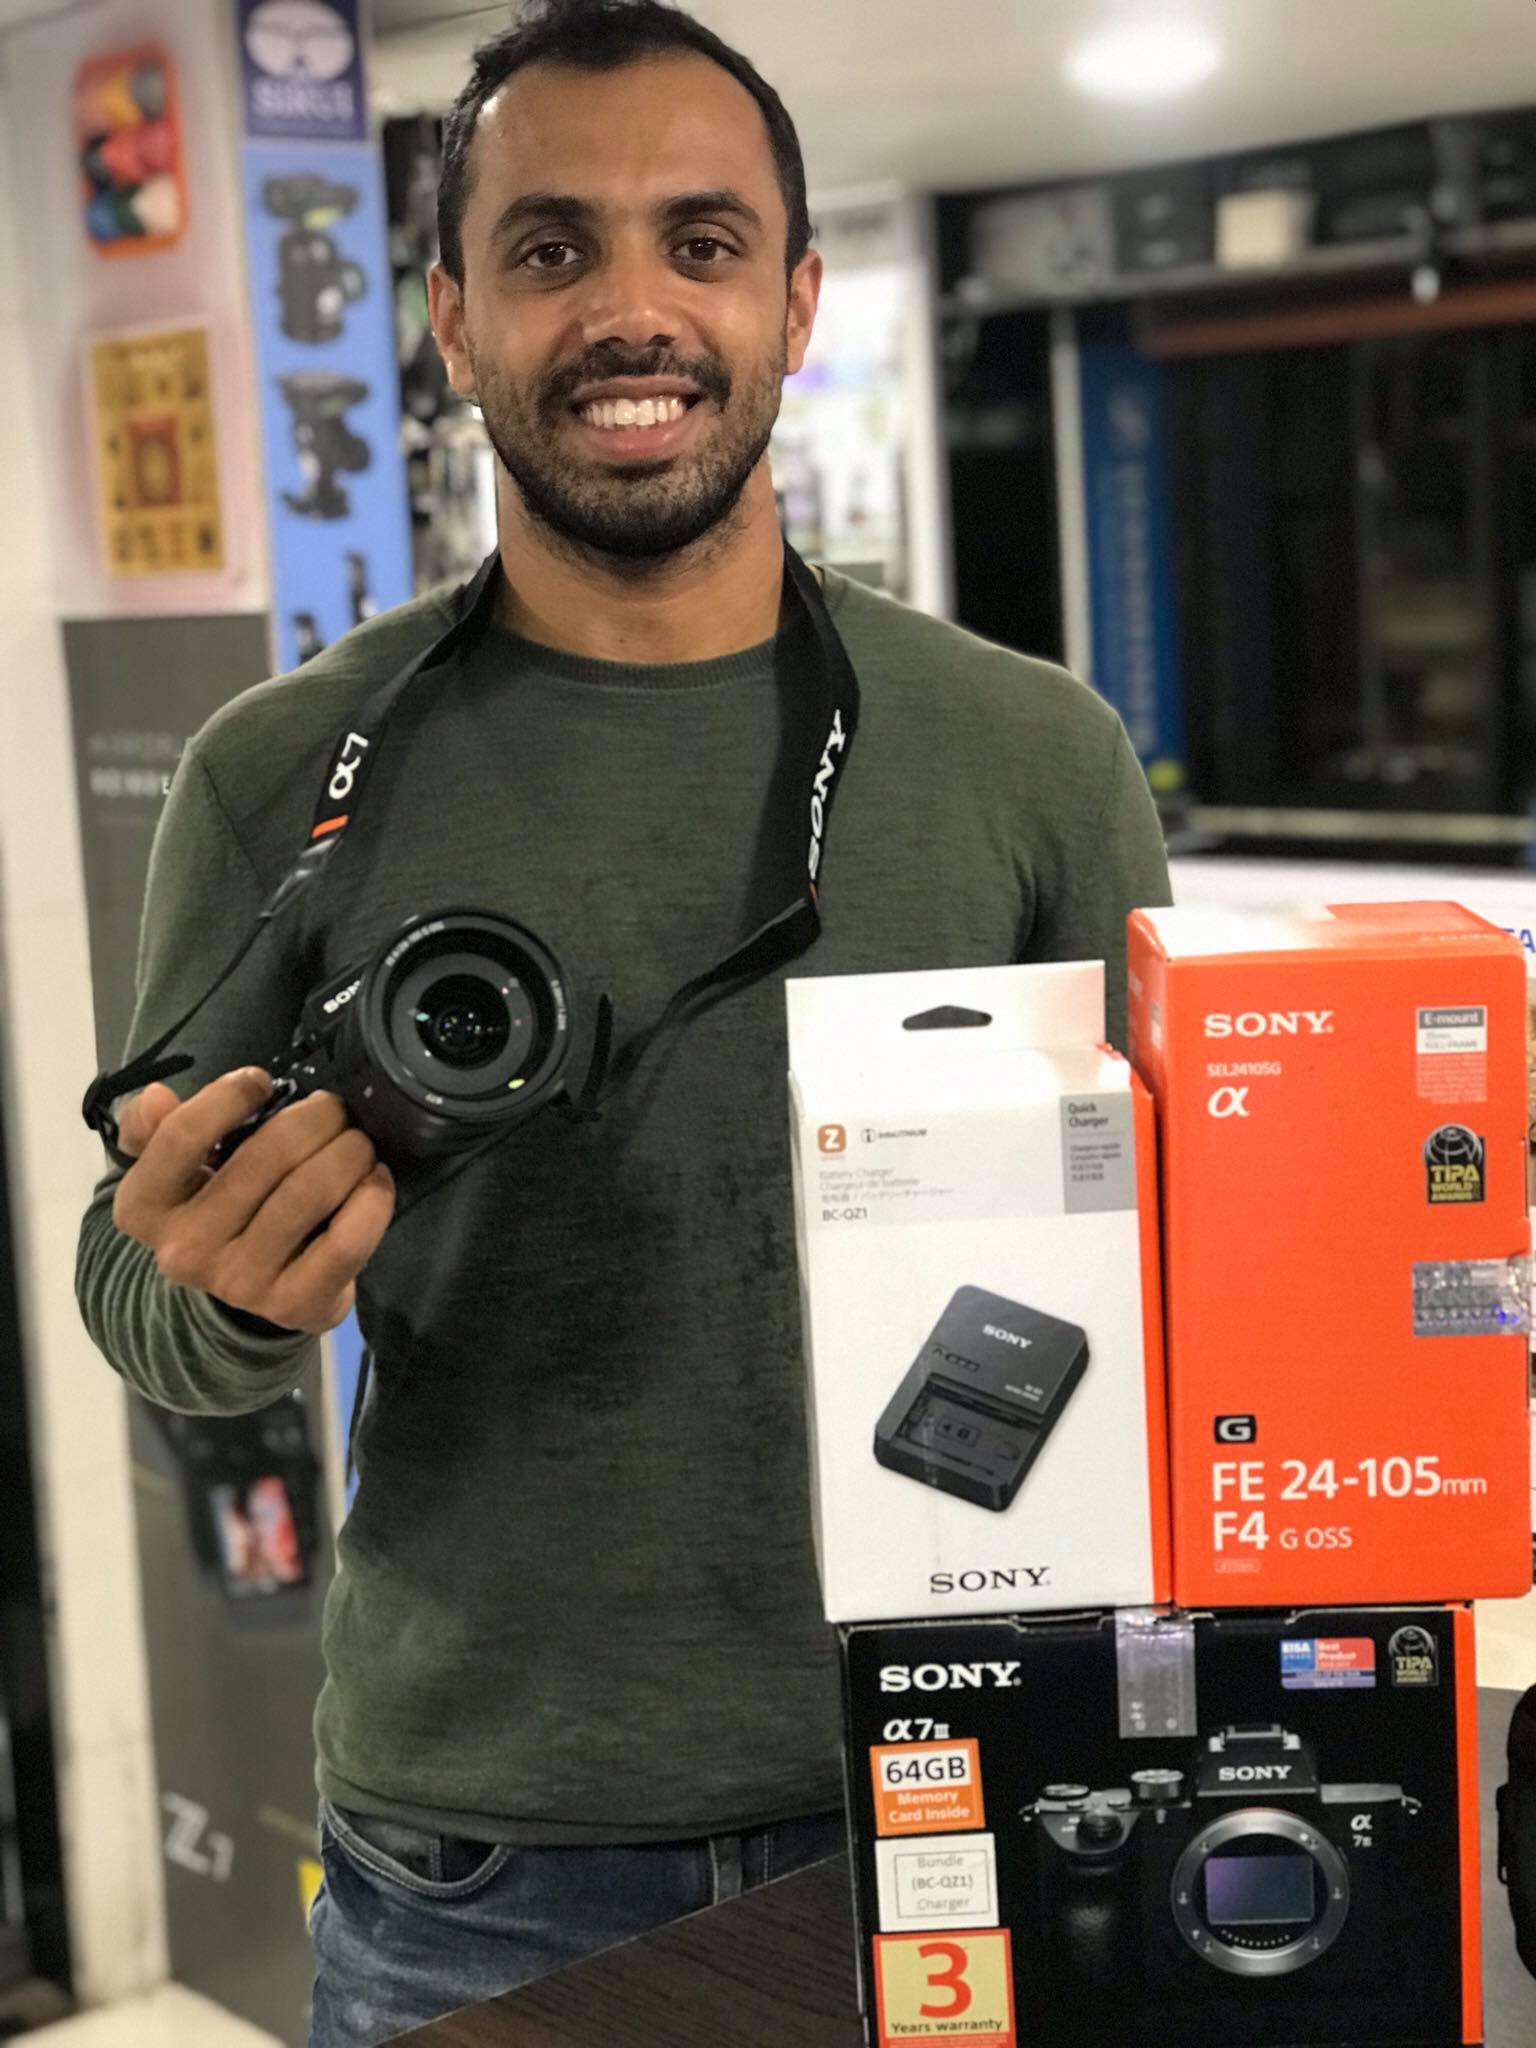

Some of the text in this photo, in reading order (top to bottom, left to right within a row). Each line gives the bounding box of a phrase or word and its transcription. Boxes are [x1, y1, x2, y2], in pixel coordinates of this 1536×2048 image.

[1068, 1102, 1097, 1115] Quick
[1069, 1115, 1109, 1129] Charger
[1430, 1163, 1480, 1183] TIPA
[821, 1207, 868, 1221] BC-QZ1
[982, 1323, 1033, 1349] SONY
[1212, 1455, 1488, 1502] FE 24-105mm
[1213, 1510, 1354, 1552] F4 G OSS
[929, 1566, 1052, 1594] SONY
[1395, 1655, 1434, 1670] TIPA
[879, 1660, 1023, 1693] SONY
[886, 1756, 967, 1784] 64GB
[1217, 1765, 1293, 1782] SONY
[896, 1790, 960, 1806] Memory
[888, 1805, 971, 1824] Card Inside
[917, 1855, 965, 1869] Bundle
[911, 1874, 974, 1891] (BC-QZ1)
[916, 1896, 970, 1912] Charger
[917, 1941, 973, 2019] 3
[891, 2018, 1003, 2034] Years warranty
